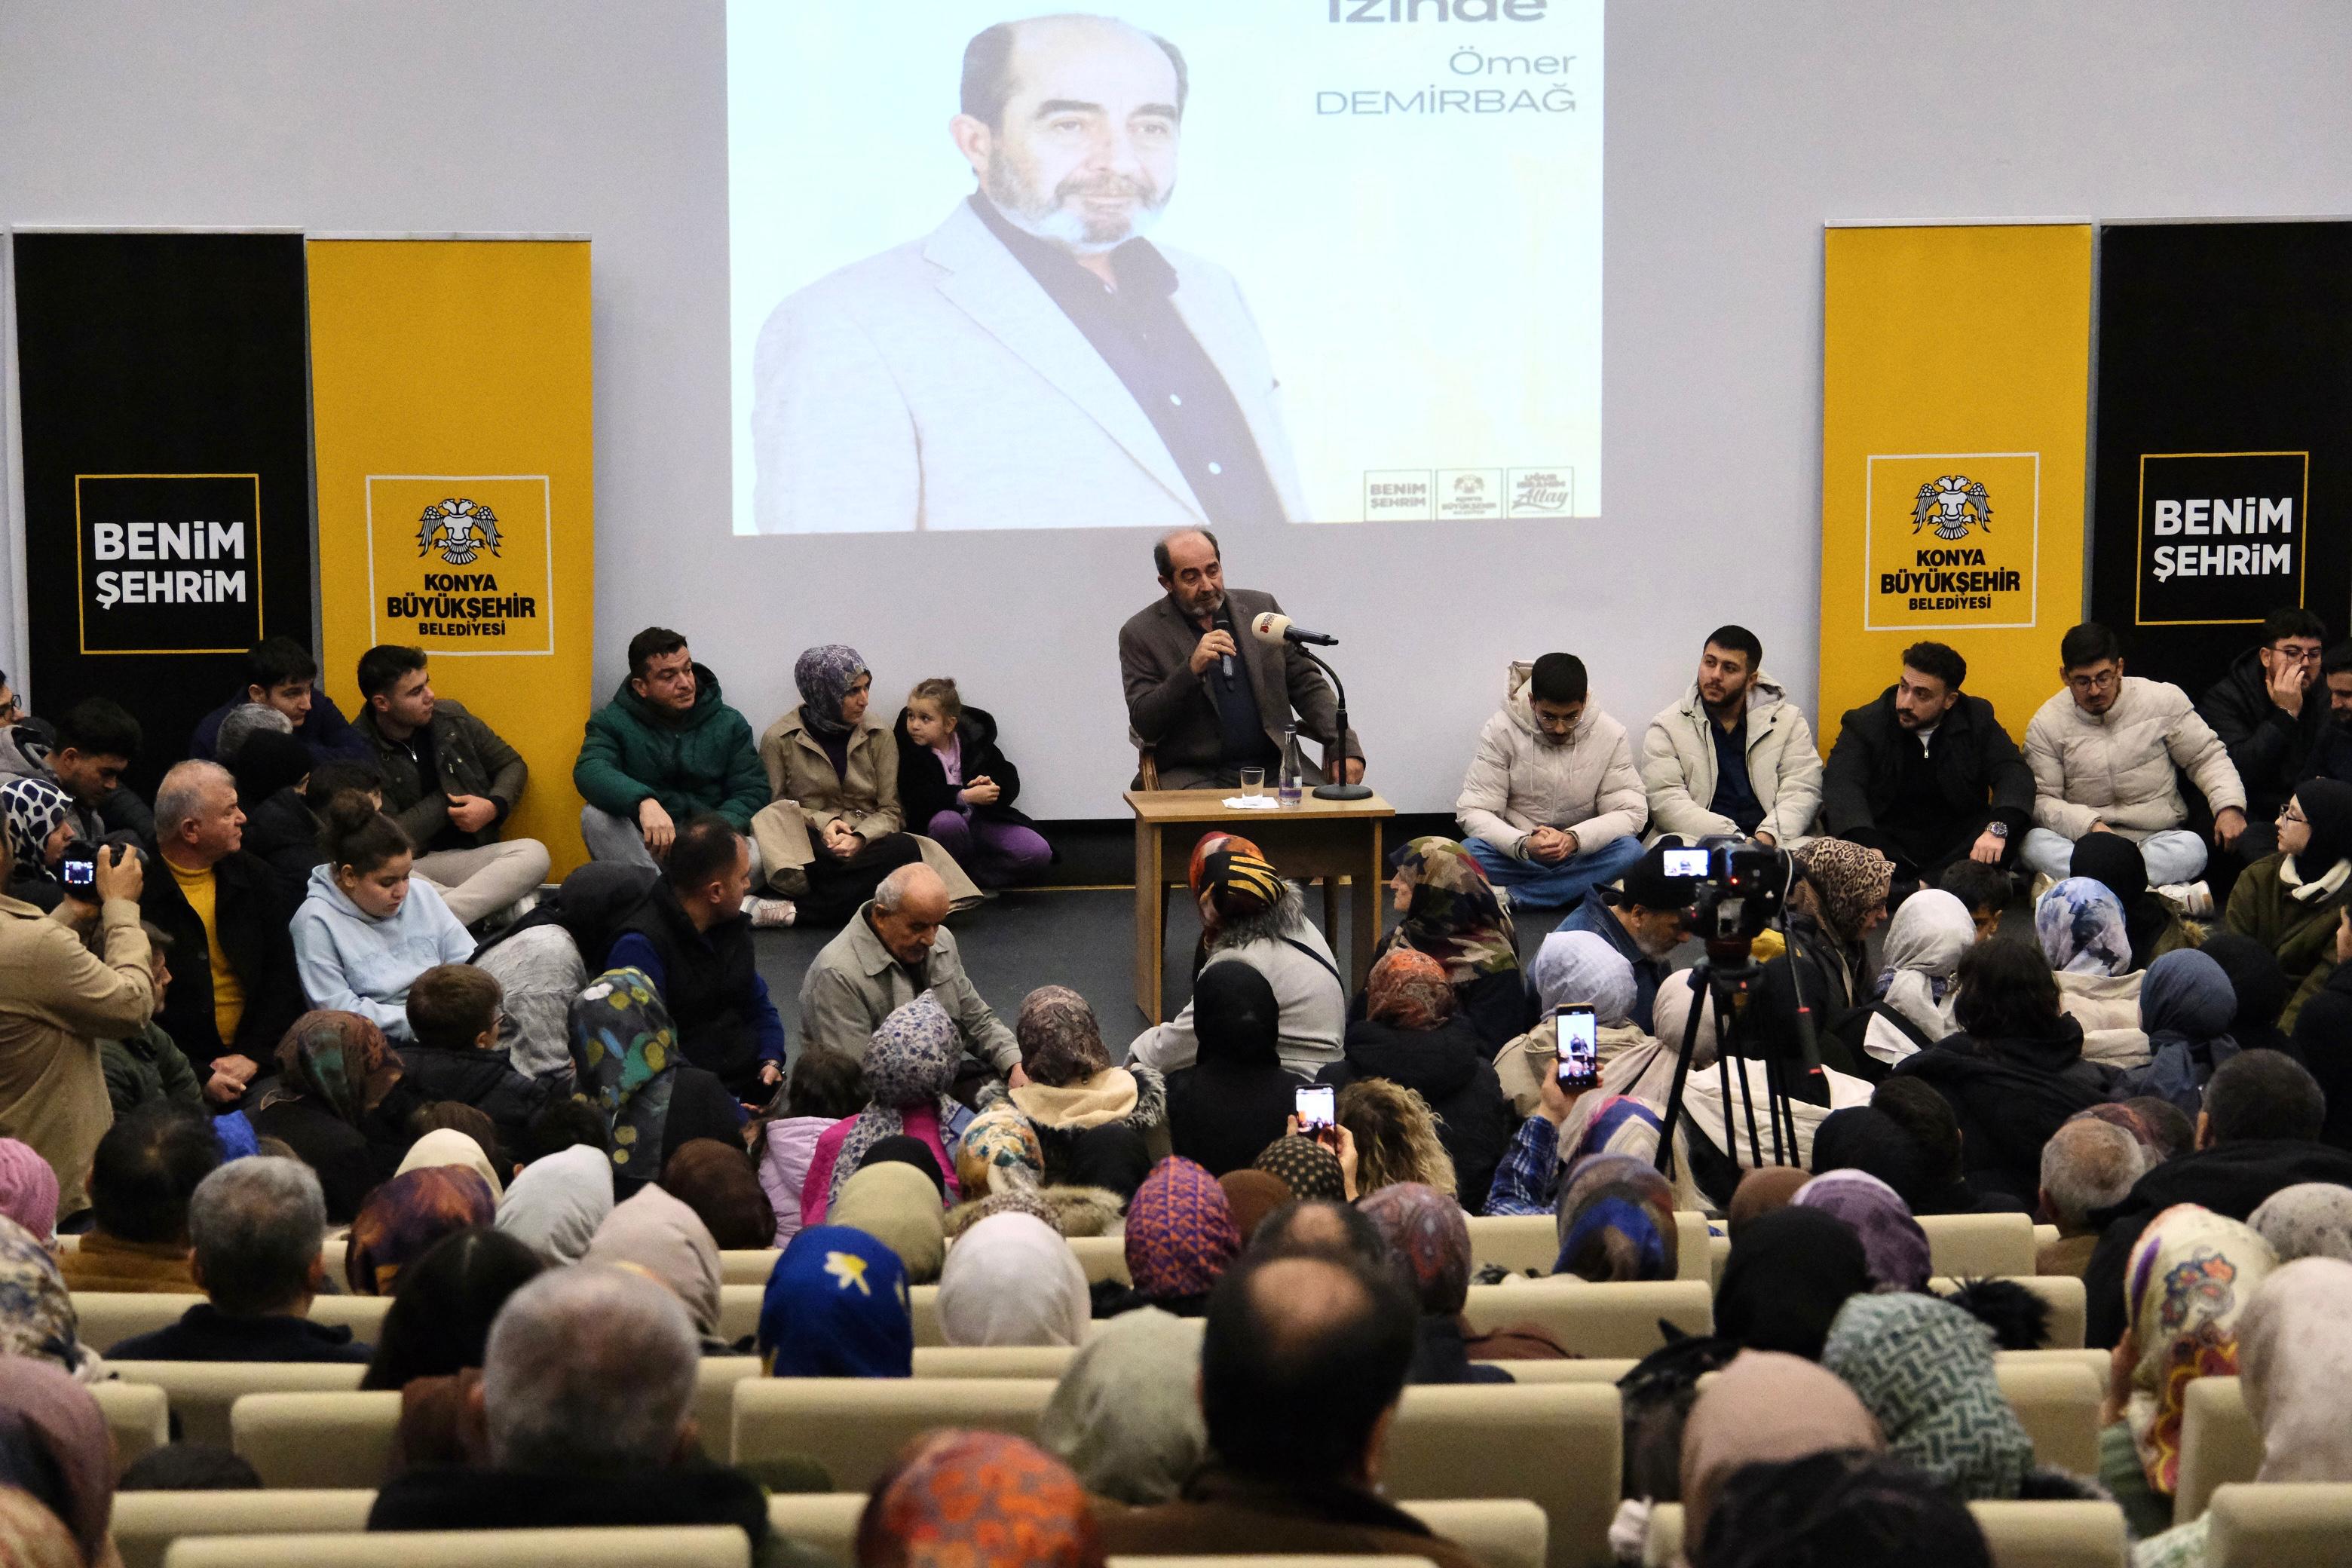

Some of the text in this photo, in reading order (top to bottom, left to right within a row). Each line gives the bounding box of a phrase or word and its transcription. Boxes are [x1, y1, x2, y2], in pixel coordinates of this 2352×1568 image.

[1449, 45, 1576, 75] Ömer
[1316, 83, 1576, 115] DEMİRBAĞ
[1916, 549, 1986, 567] KONYA
[424, 574, 498, 593] KONYA
[1880, 566, 2020, 596] BÜYÜKŞEHİR
[387, 596, 536, 623] BÜYÜKŞEHİR
[1909, 594, 1992, 611] BELEDİYESİ
[418, 620, 506, 636] BELEDİYESİ
